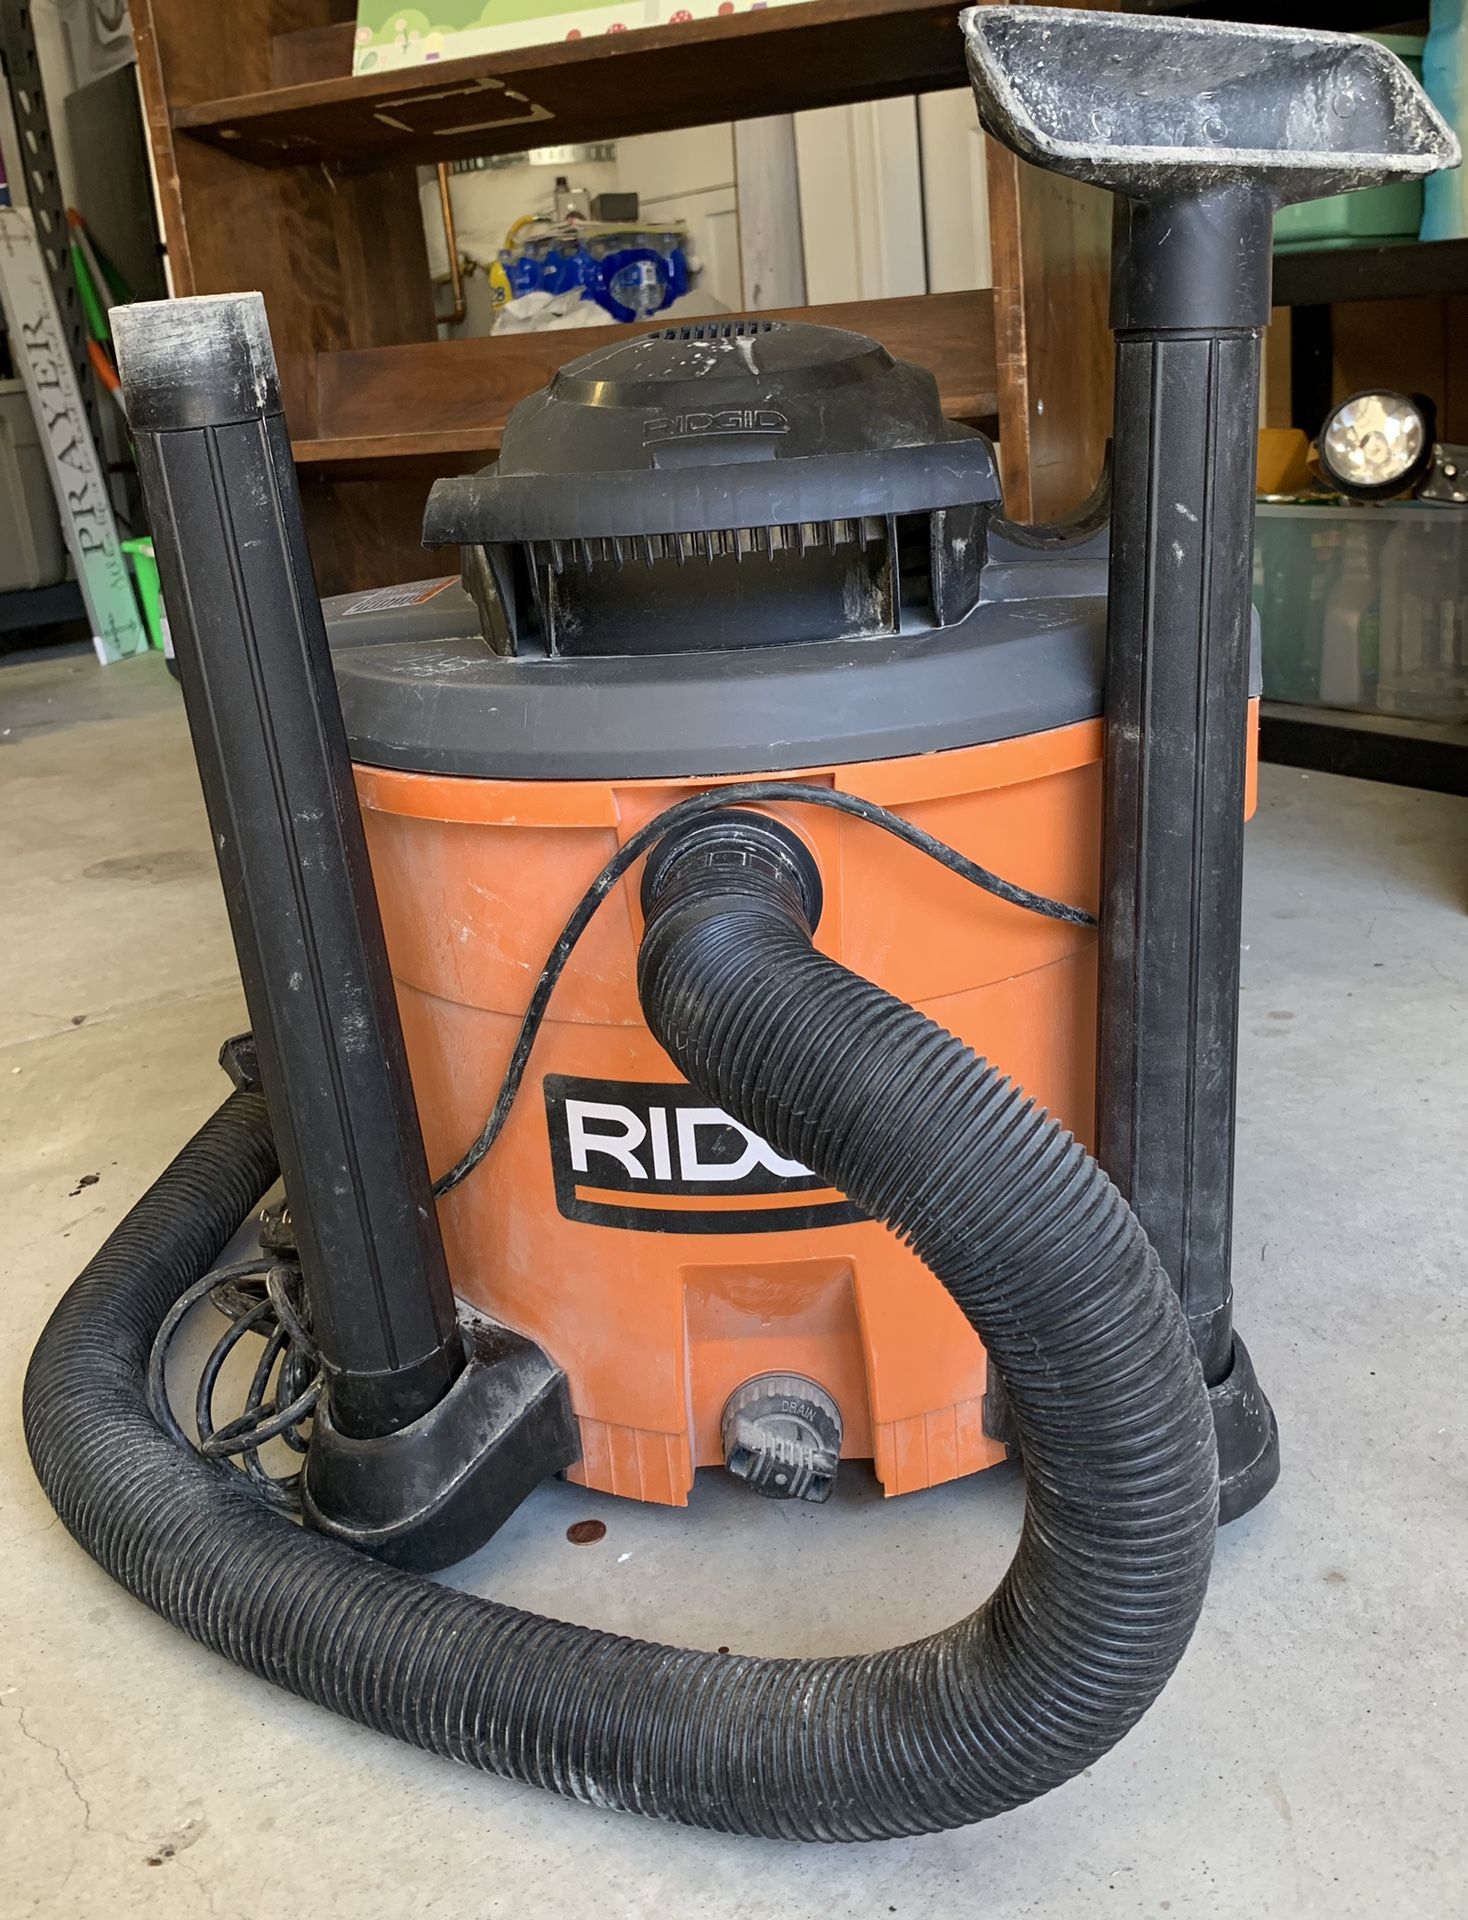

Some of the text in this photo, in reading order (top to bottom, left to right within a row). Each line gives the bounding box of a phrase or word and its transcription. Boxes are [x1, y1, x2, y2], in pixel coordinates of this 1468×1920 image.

[22, 316, 106, 559] PRAYER
[643, 410, 788, 435] RIDGID
[566, 1099, 815, 1181] RID
[782, 1401, 815, 1421] DRAIN
